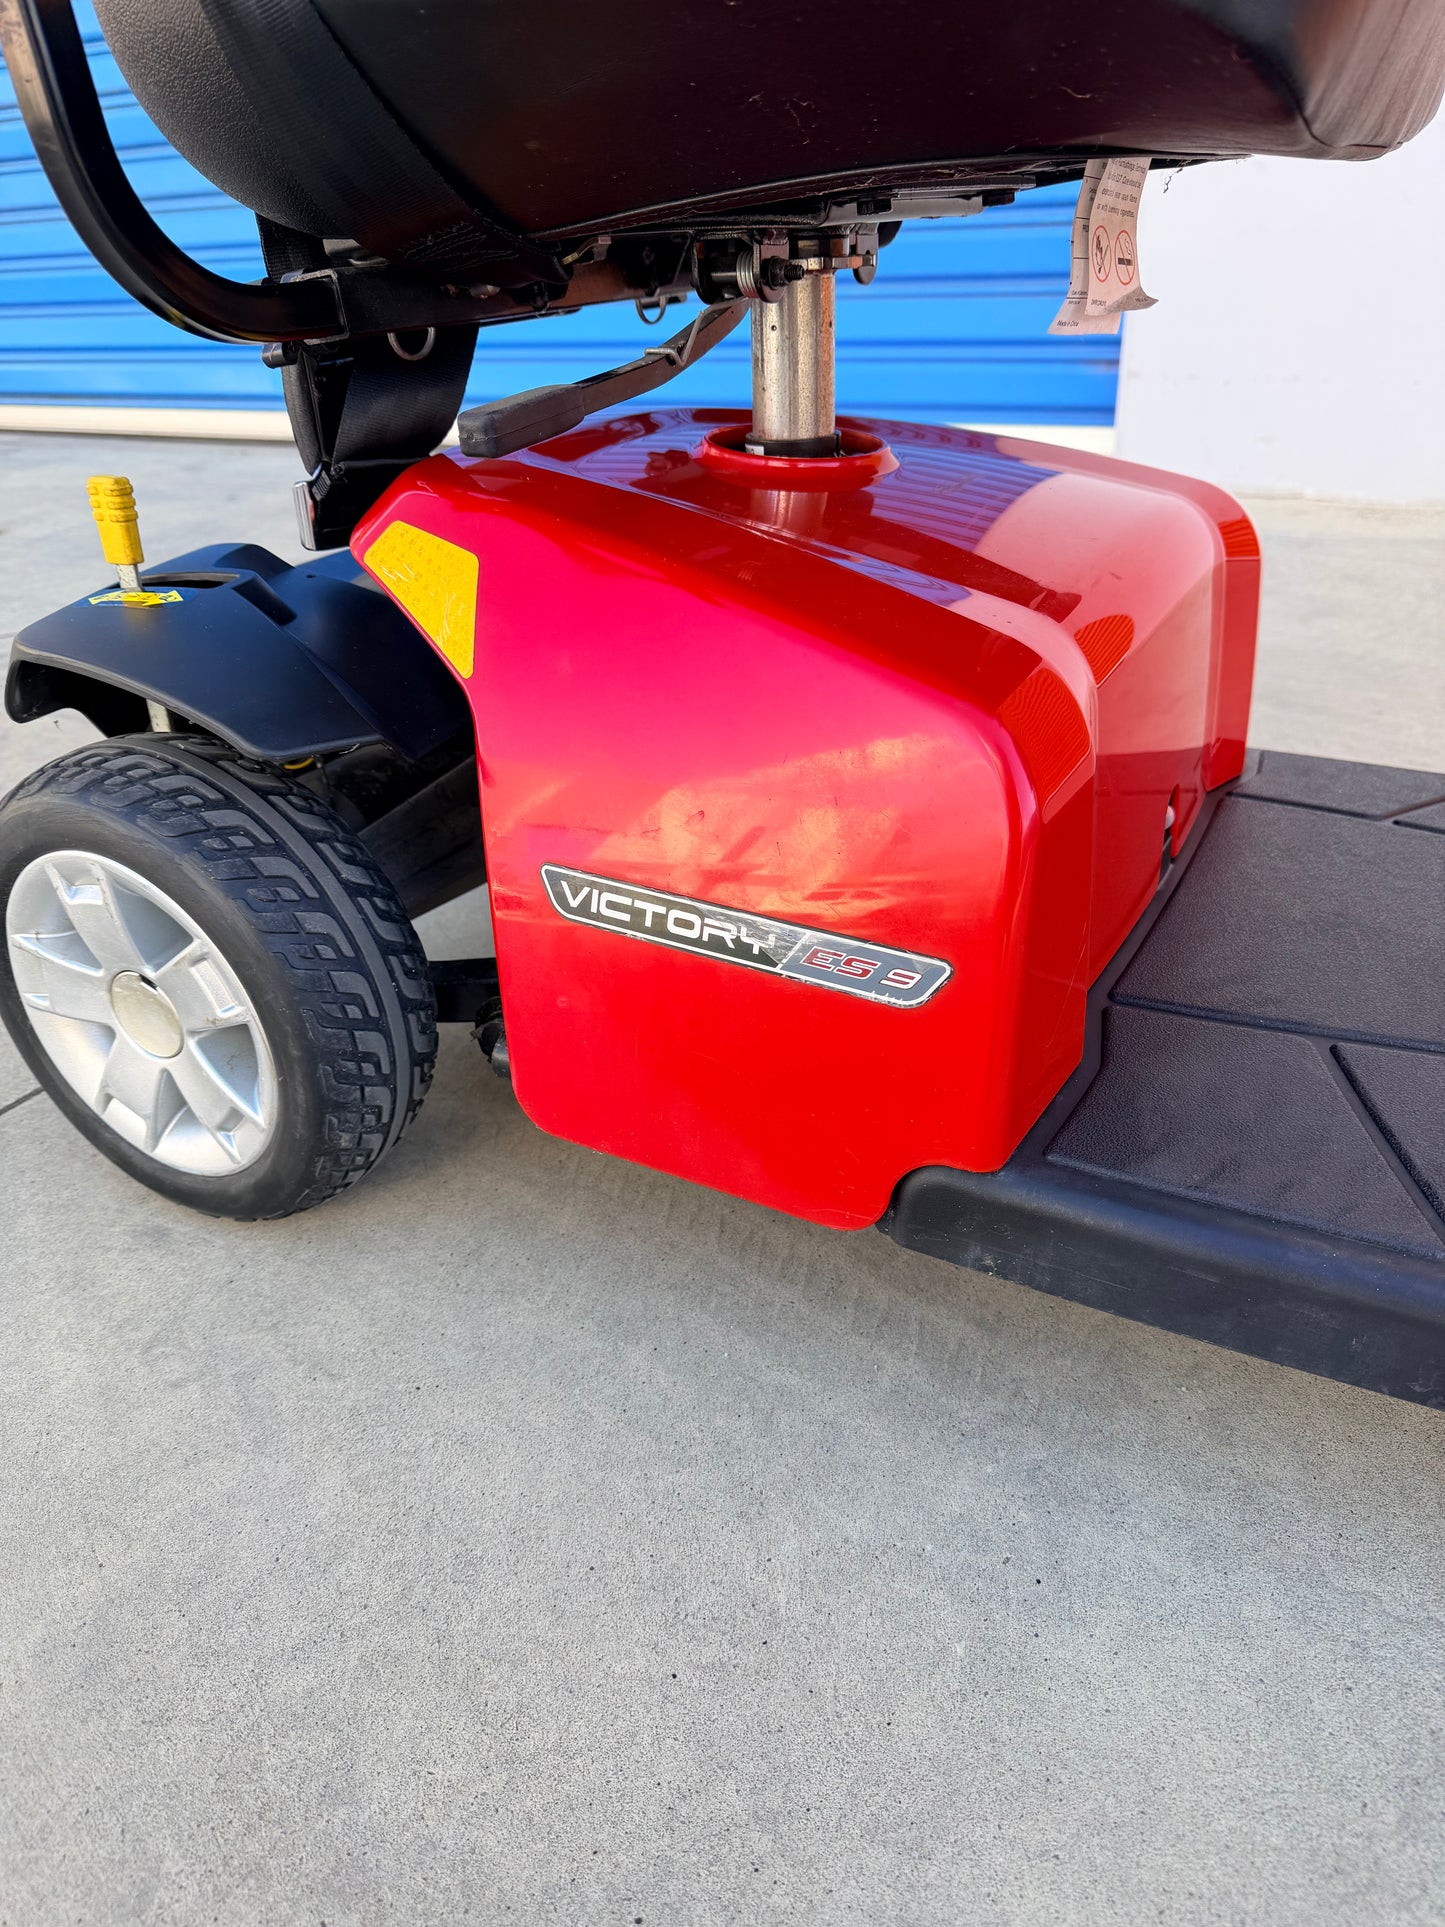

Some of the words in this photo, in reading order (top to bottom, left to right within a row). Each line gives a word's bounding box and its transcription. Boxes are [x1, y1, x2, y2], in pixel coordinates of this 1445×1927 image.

[560, 880, 776, 955] VICTORY
[800, 946, 882, 980] ES
[879, 968, 923, 990] 9
